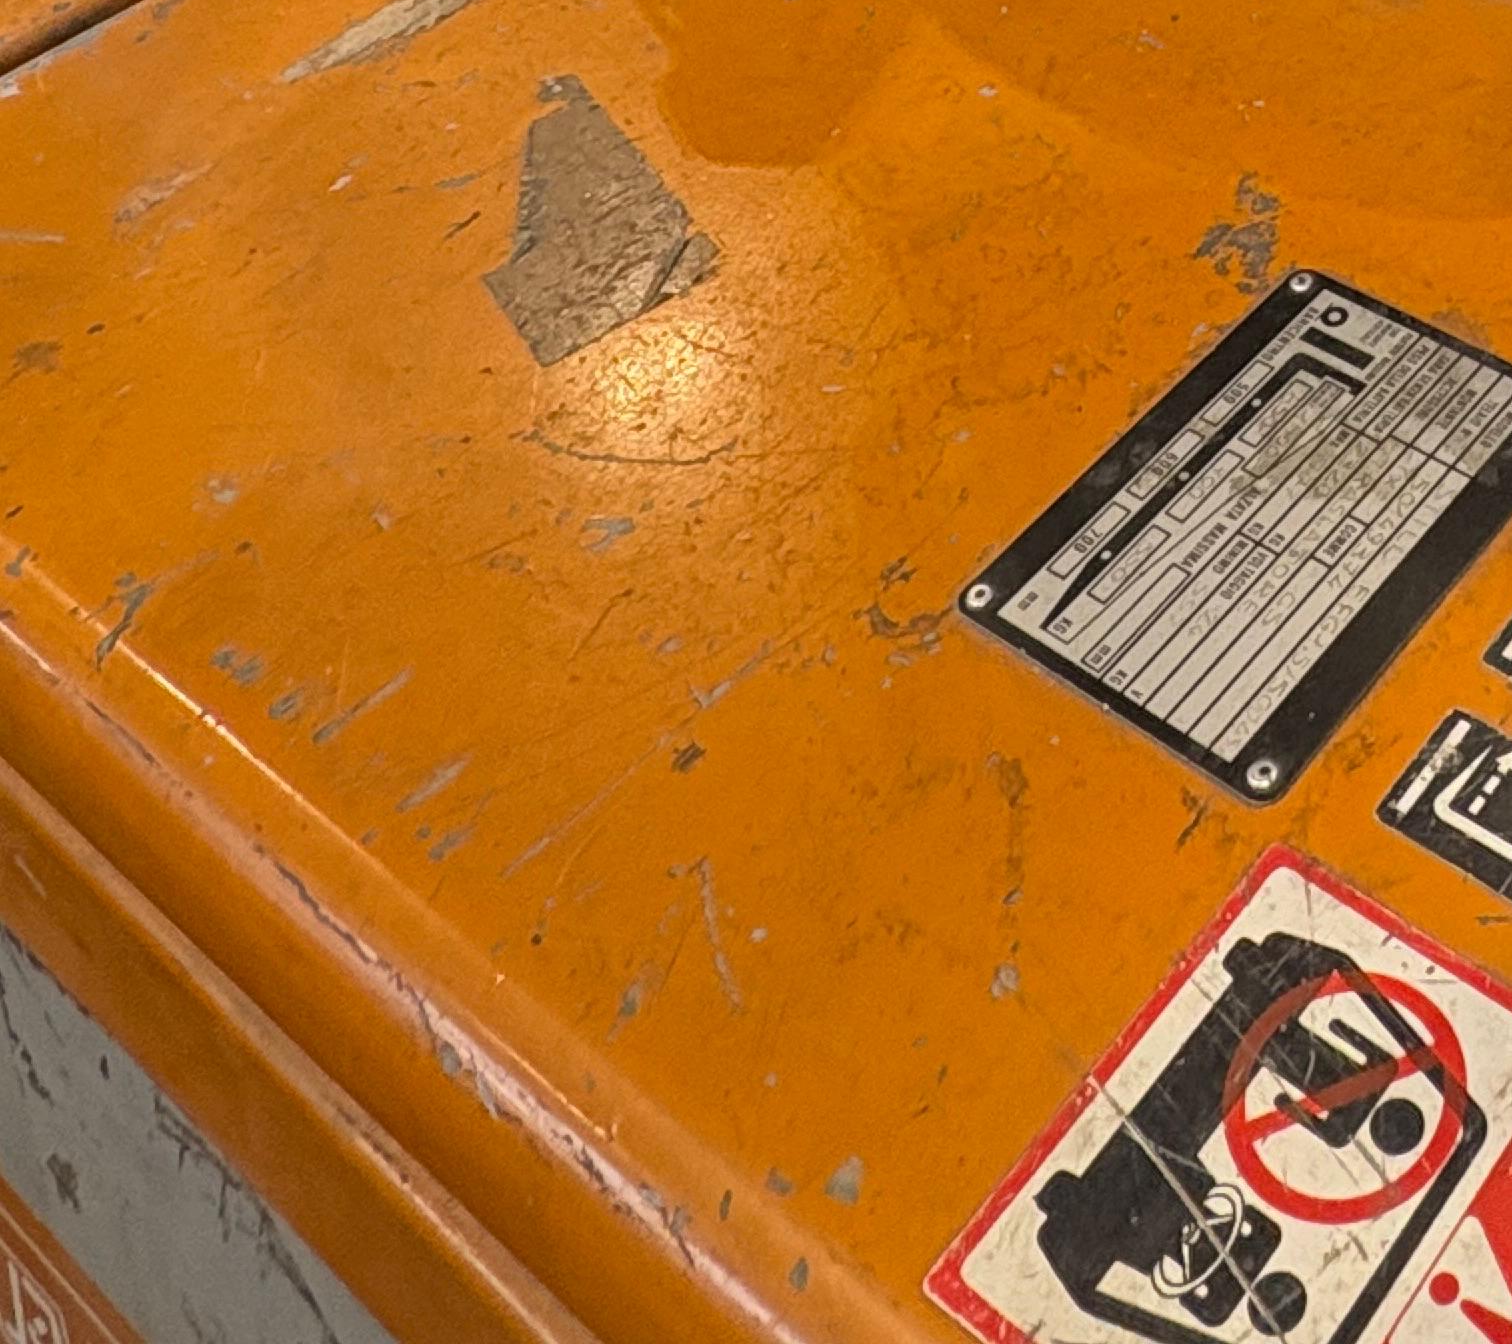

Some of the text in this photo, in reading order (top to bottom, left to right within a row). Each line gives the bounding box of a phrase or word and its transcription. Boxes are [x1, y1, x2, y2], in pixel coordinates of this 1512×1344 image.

[1223, 485, 1263, 522] ALZATA
[1071, 527, 1103, 555] 700
[1178, 521, 1229, 569] MASSIMA
[1210, 538, 1249, 575] MINIMO
[1218, 549, 1270, 601] VOLTAGGIO
[1051, 615, 1075, 635] KG
